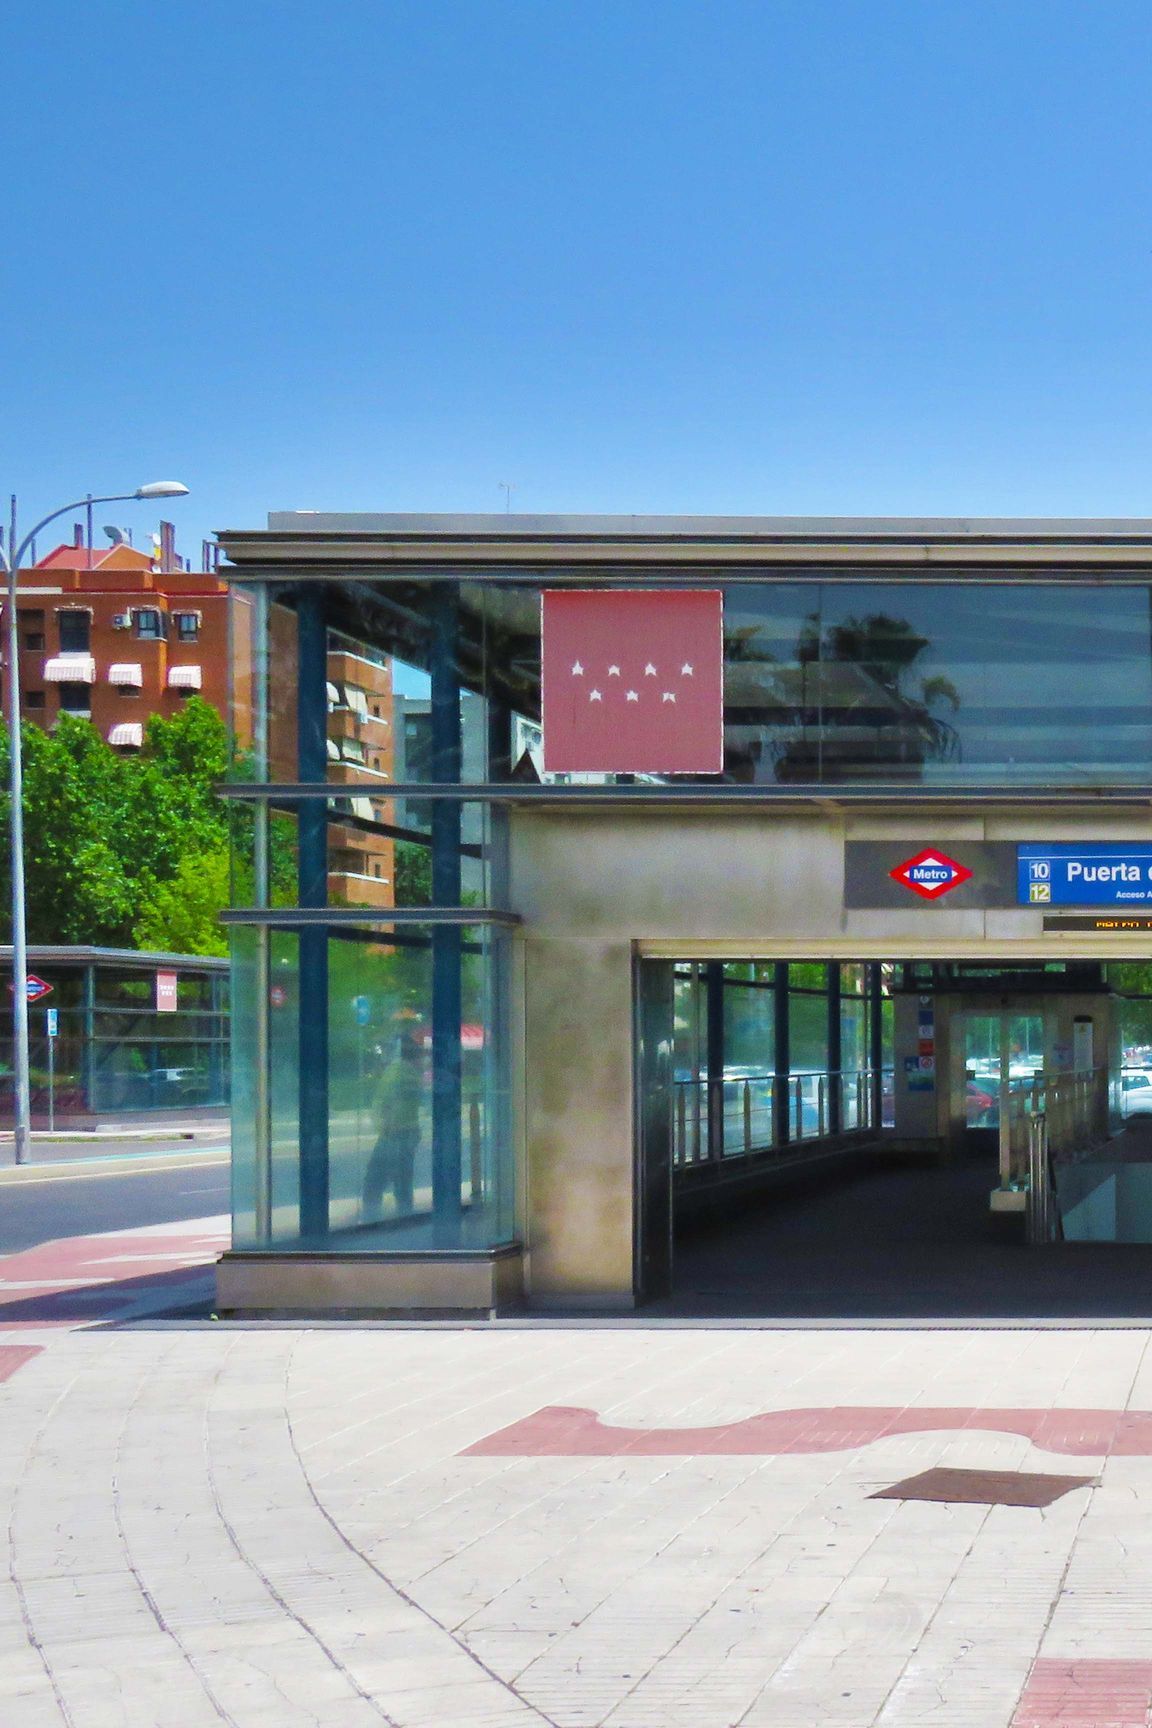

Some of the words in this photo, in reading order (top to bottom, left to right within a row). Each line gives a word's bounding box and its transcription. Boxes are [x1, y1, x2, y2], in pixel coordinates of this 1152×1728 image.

[913, 869, 948, 879] Metro
[1030, 863, 1049, 878] 10
[1067, 862, 1141, 882] Puerta
[1030, 885, 1049, 901] 12
[1115, 890, 1145, 899] Acceso
